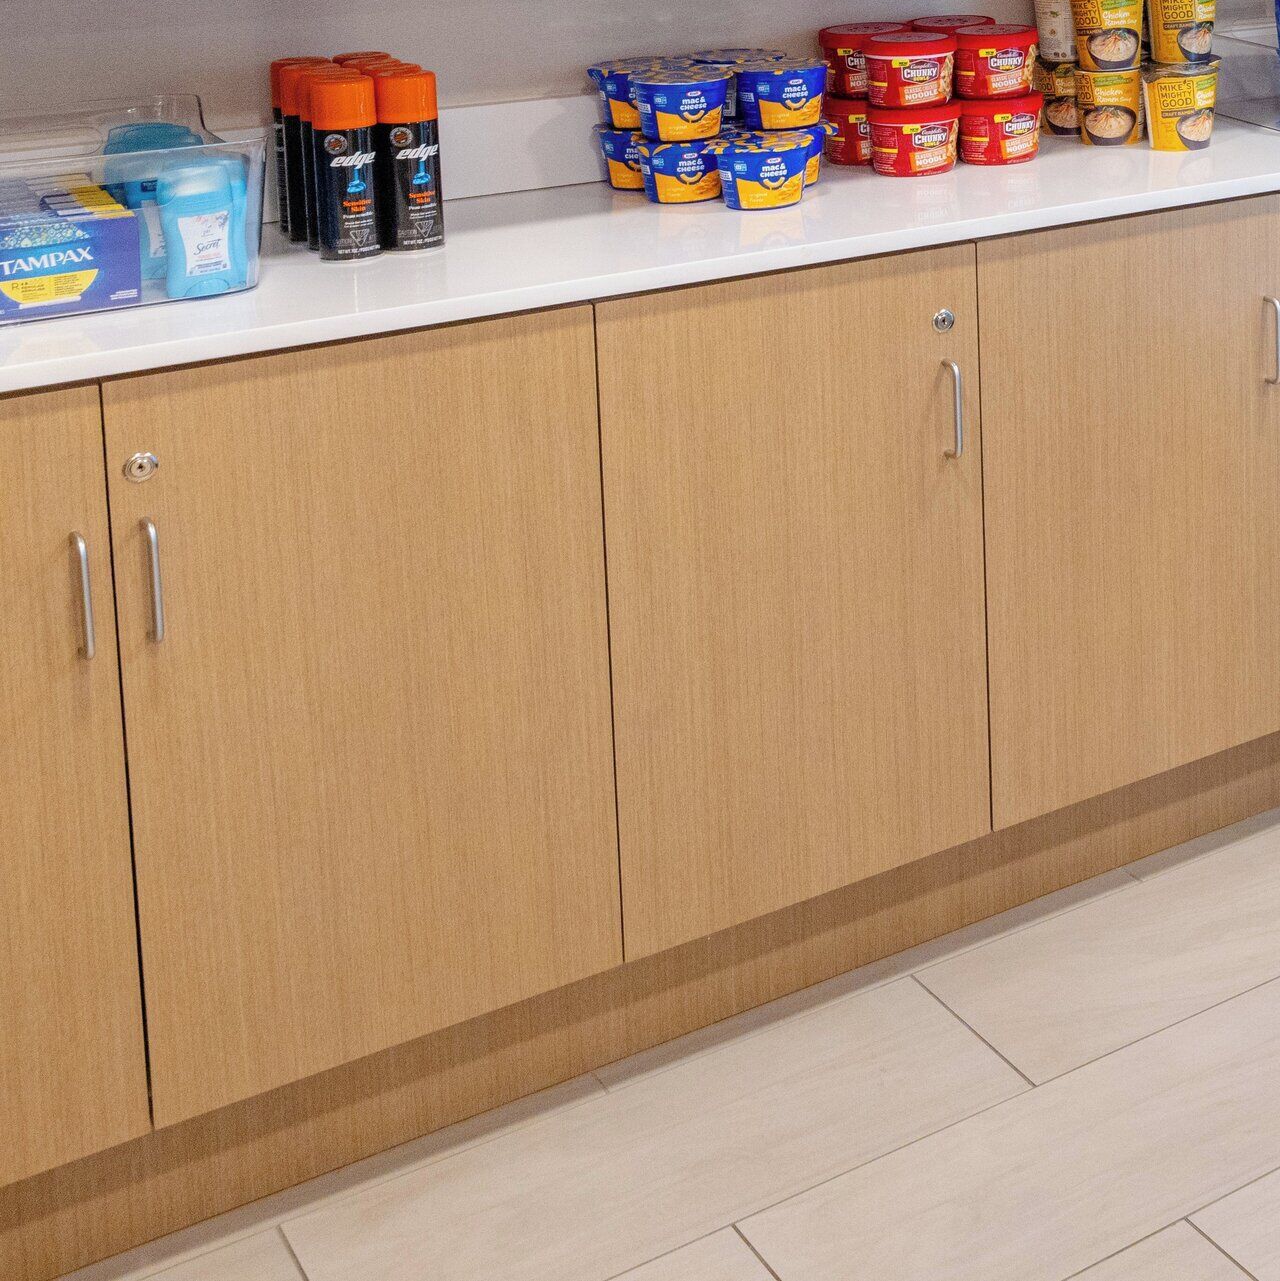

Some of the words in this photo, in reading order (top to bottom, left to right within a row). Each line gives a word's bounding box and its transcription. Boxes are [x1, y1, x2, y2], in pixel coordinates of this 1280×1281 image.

[1163, 3, 1194, 11] MIGHTY
[1103, 10, 1130, 19] Chicken
[1164, 10, 1193, 20] GOOD
[1104, 17, 1126, 25] Ramen
[990, 57, 1022, 67] CHUNKY
[903, 68, 938, 78] CHUNKY
[992, 78, 1022, 89] NOODLE
[1160, 81, 1192, 92] MIKE'S
[905, 90, 938, 101] NOODLE
[1095, 88, 1123, 96] Chicken
[1161, 90, 1192, 99] MIGHTY
[1097, 95, 1120, 103] Ramen
[1162, 98, 1192, 108] GOOD
[1004, 120, 1035, 131] CHUNKY
[914, 134, 947, 144] CHUNKY
[1006, 142, 1034, 152] NOODLE
[395, 143, 439, 162] edge
[329, 151, 377, 170] edge
[915, 154, 947, 167] NOODLE
[193, 238, 223, 256] Secret
[0, 246, 94, 276] TAMPAX
